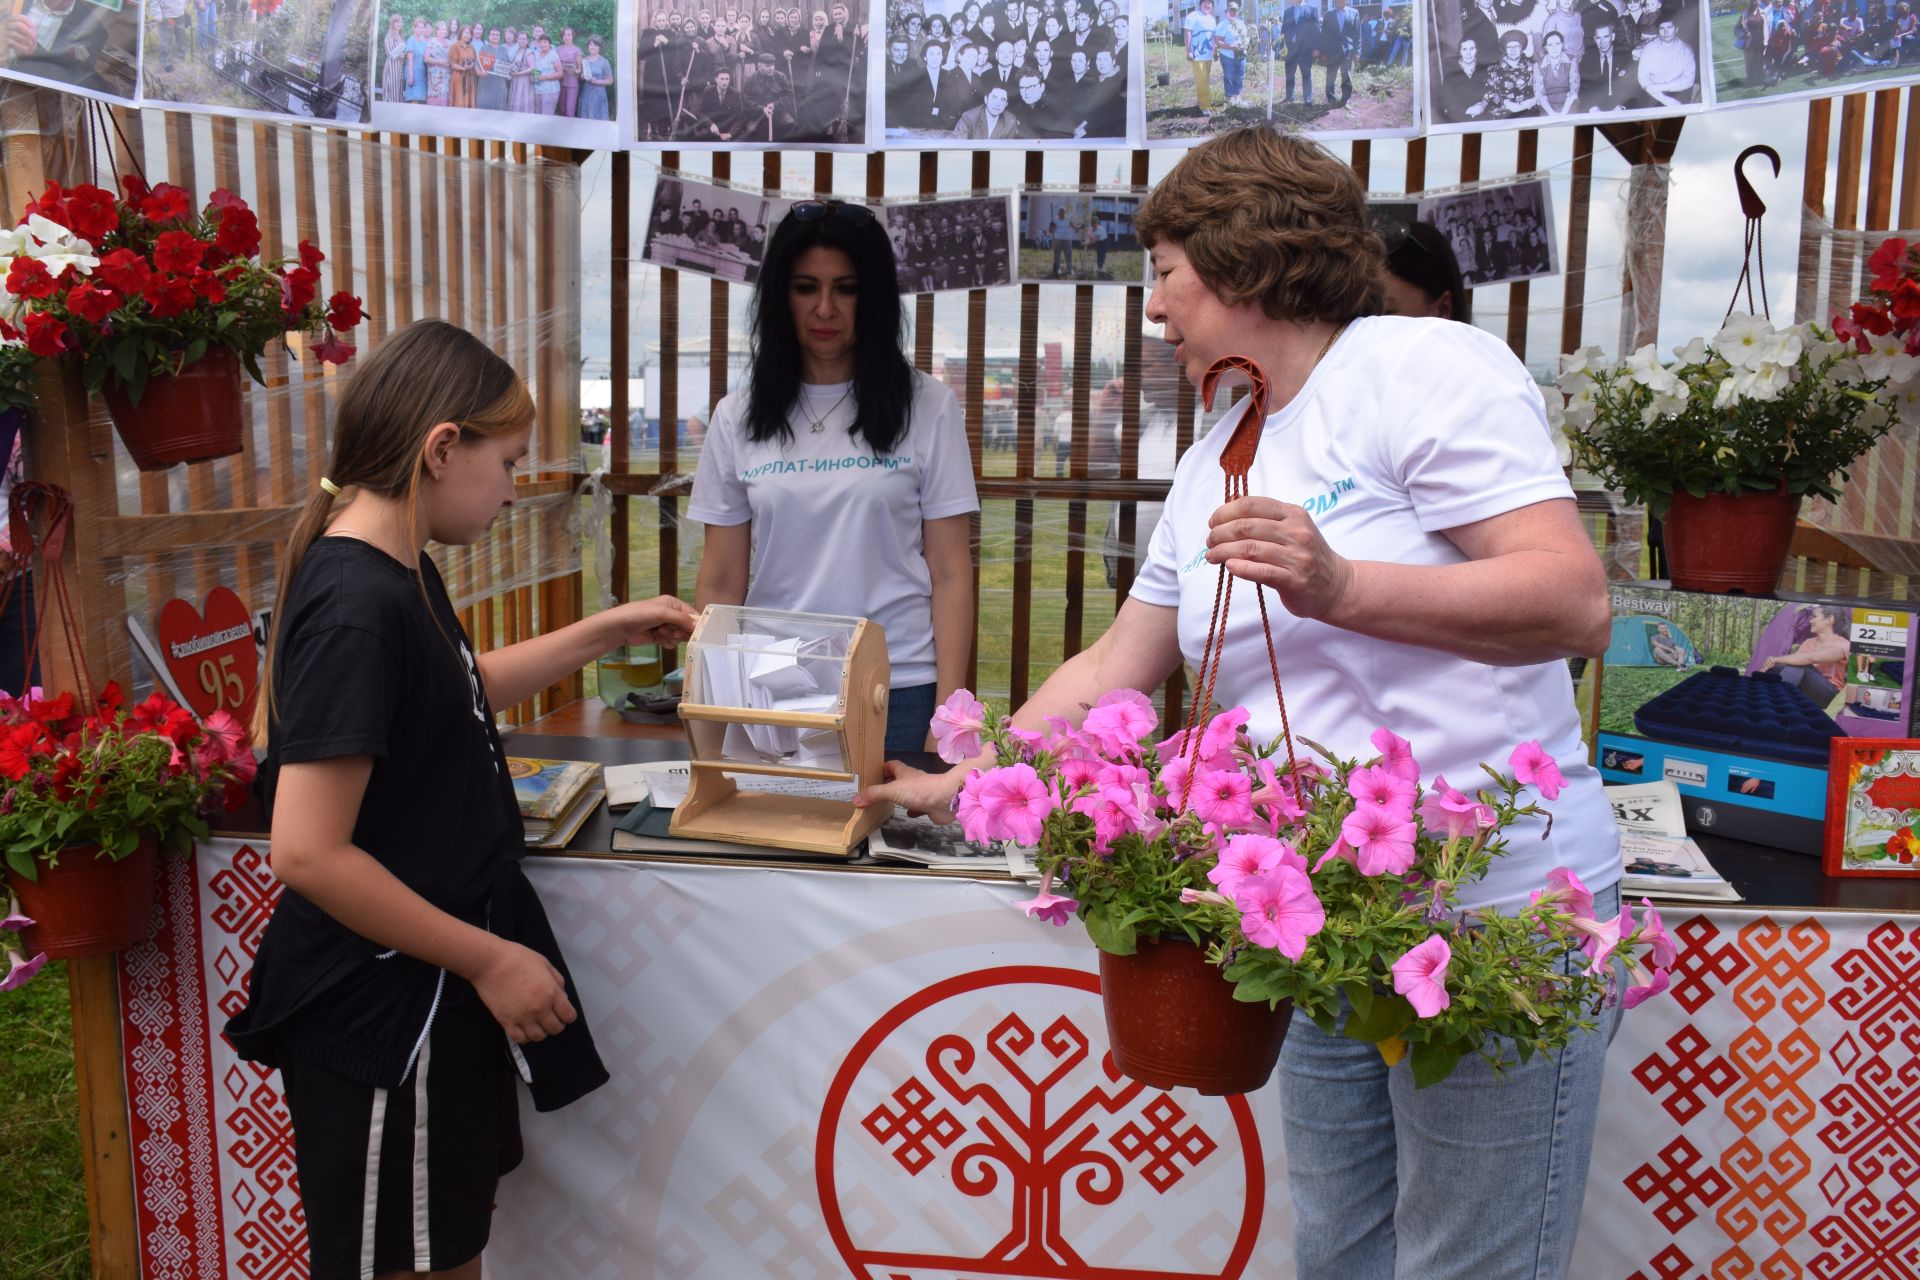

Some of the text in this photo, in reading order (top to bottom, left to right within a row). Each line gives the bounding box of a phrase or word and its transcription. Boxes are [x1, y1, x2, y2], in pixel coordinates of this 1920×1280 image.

[1612, 593, 1672, 616] Bestway
[1858, 628, 1877, 640] 22
[199, 653, 244, 709] 95
